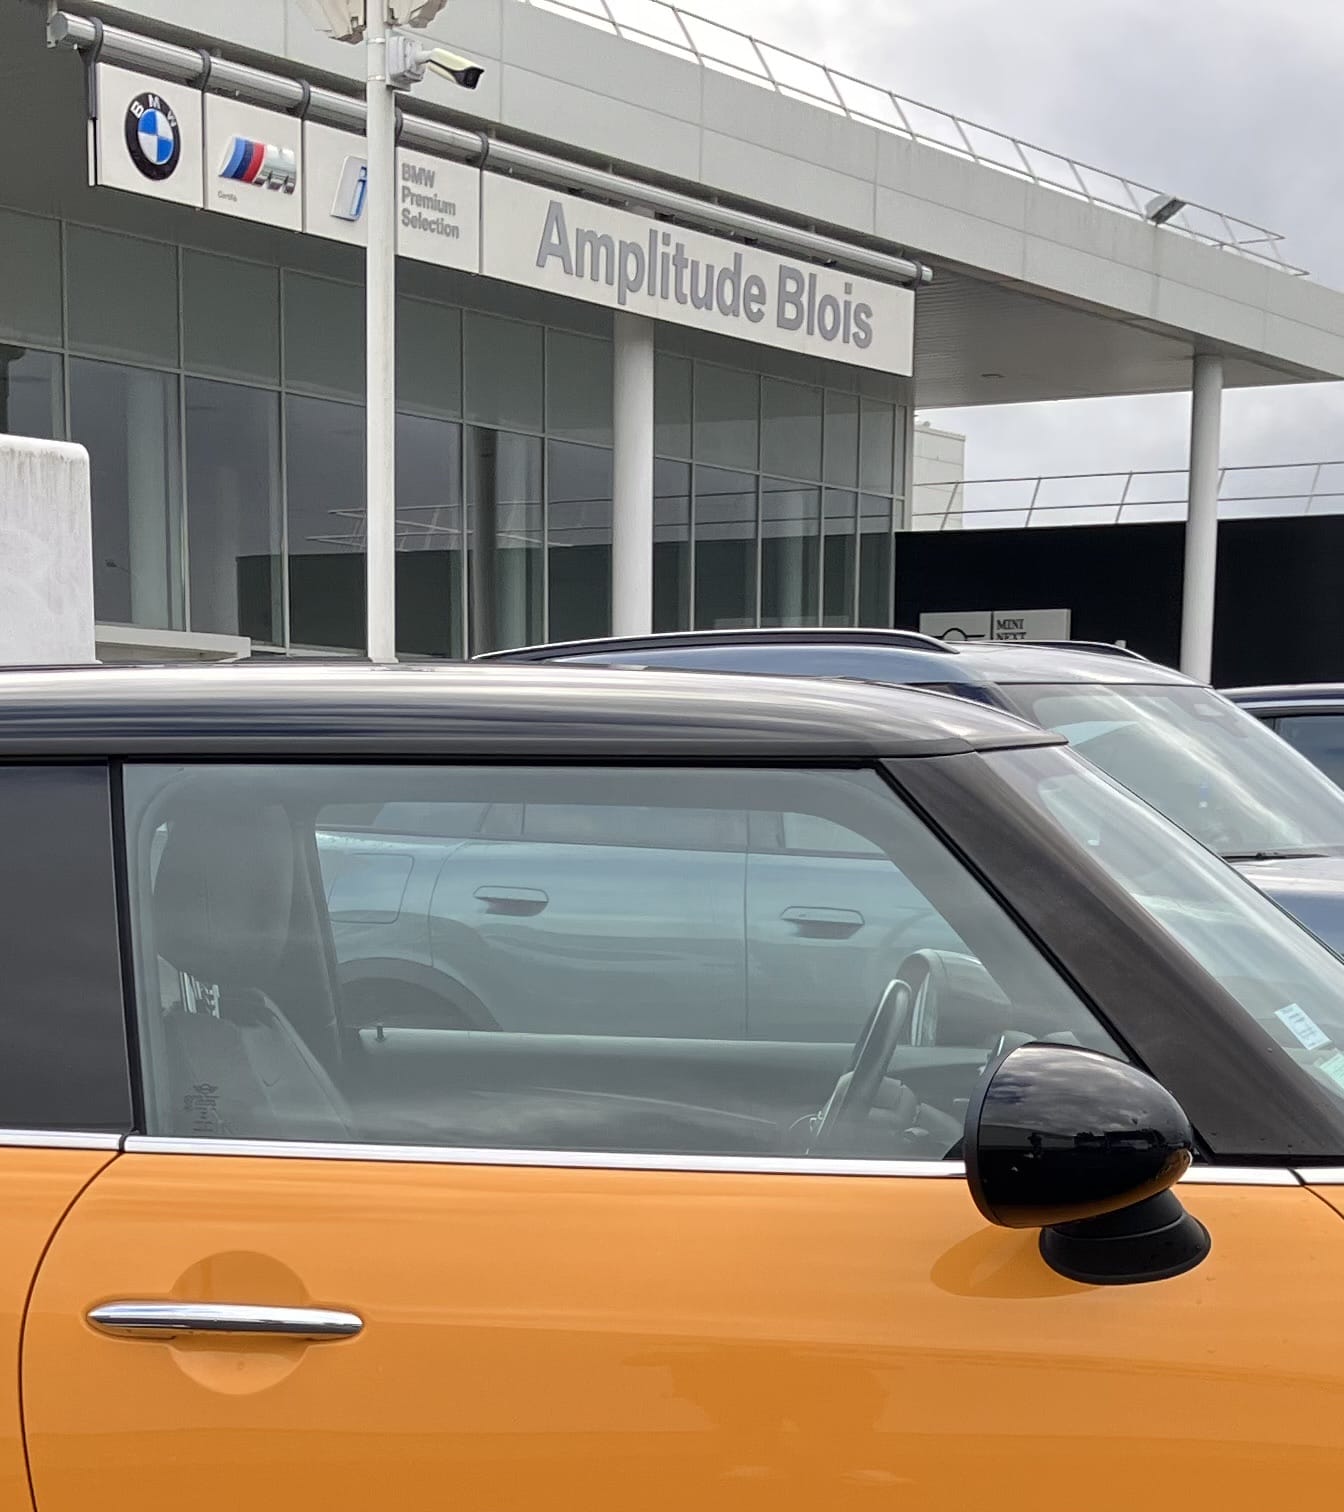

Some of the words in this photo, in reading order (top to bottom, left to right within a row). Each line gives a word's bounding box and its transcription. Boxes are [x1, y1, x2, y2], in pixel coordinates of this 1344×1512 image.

[130, 94, 177, 128] BMW
[401, 162, 435, 189] BMW
[401, 185, 456, 216] Premium
[401, 208, 460, 239] Selection
[536, 200, 767, 324] Amplitude
[777, 264, 873, 349] Blois
[996, 618, 1024, 630] MINI
